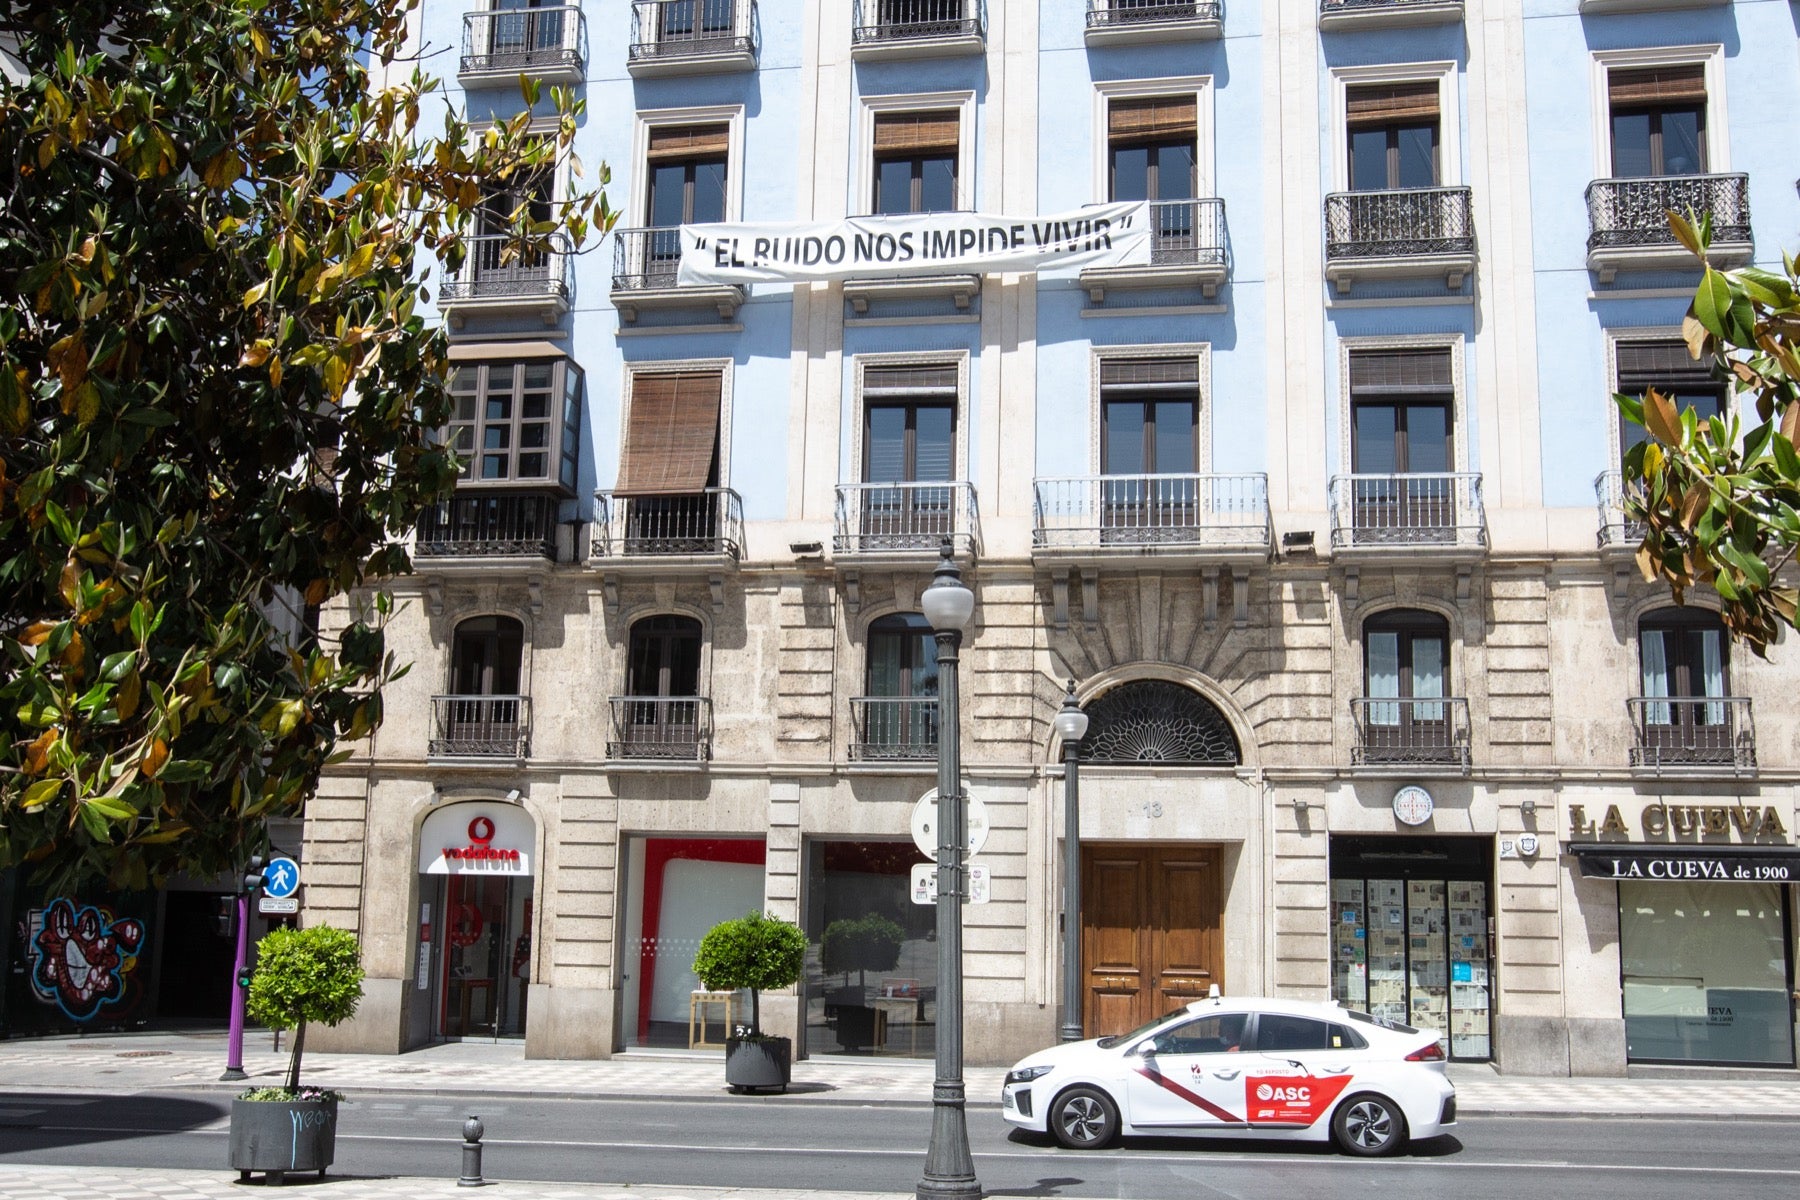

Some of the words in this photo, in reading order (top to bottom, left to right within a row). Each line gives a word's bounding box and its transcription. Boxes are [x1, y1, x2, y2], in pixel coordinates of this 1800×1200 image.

[715, 238, 745, 267] EL
[753, 235, 846, 267] RUIDO
[854, 232, 914, 264] NOS
[922, 224, 1025, 259] IMPIDE
[1032, 219, 1112, 253] VIVIR
[1143, 801, 1162, 818] 13
[1569, 804, 1629, 834] LA
[1641, 804, 1787, 834] CUEVA
[442, 845, 520, 861] vodafone
[1612, 860, 1643, 878] LA
[1648, 860, 1729, 879] CUEVA
[1734, 866, 1750, 879] de
[1755, 866, 1789, 879] 1900
[1273, 1087, 1310, 1101] ASC
